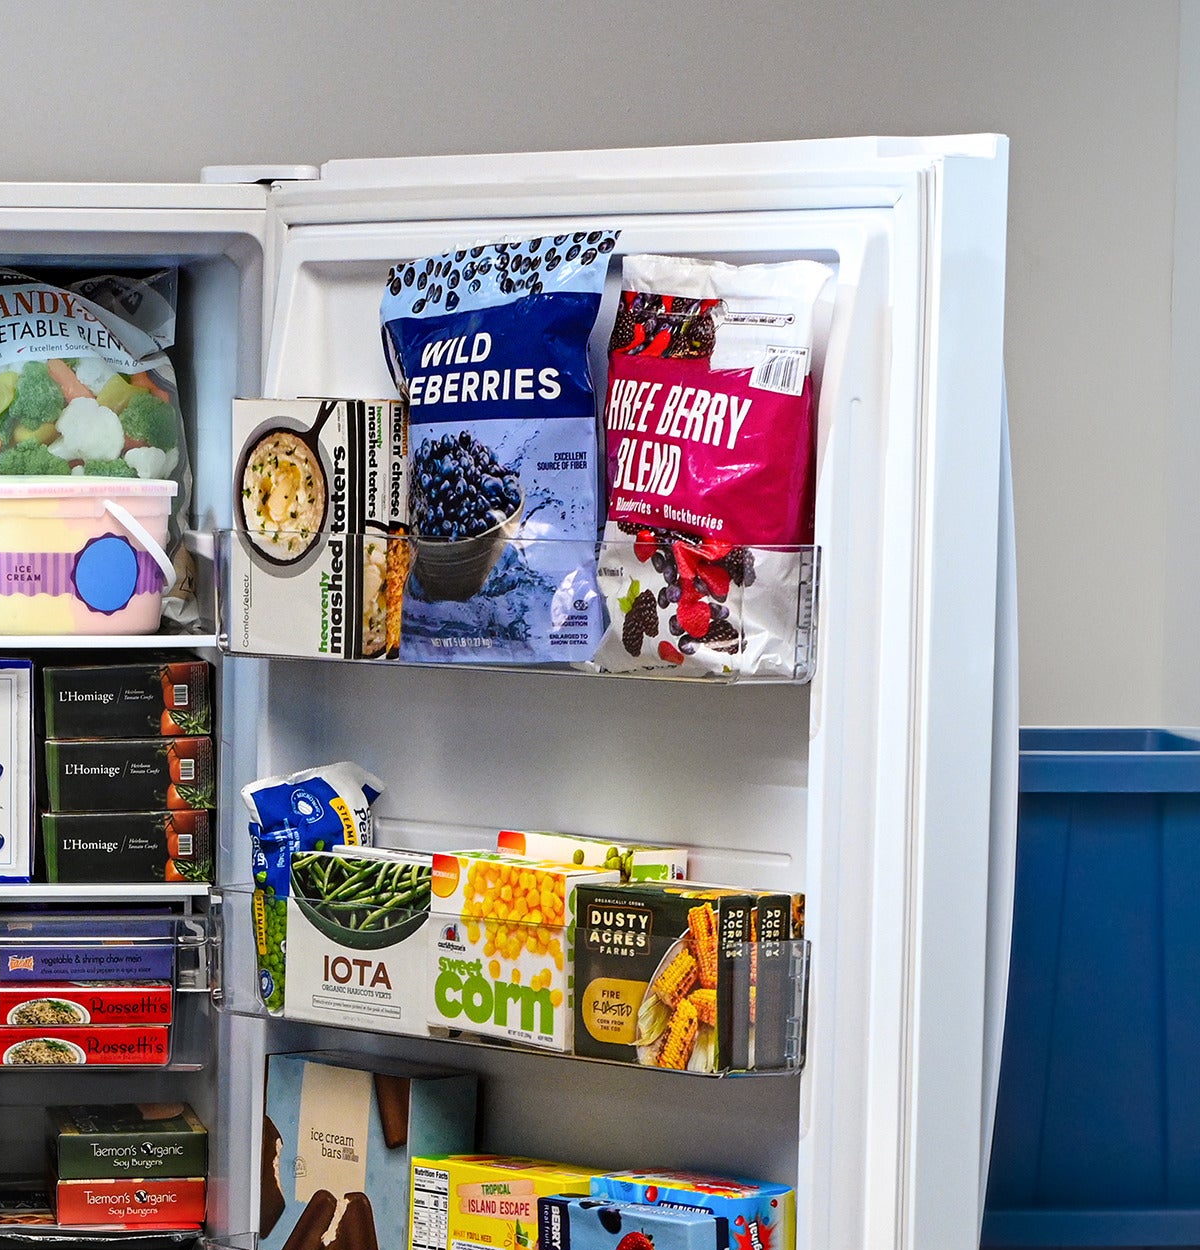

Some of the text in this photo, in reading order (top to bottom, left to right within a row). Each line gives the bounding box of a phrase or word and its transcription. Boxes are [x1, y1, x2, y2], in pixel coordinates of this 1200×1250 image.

[29, 344, 89, 353] Excellent Source
[420, 332, 492, 368] WILD
[407, 367, 563, 406] EBERRIES
[606, 378, 753, 450] HREE BERRY
[393, 406, 402, 442] mac
[368, 406, 378, 519] mashed taters
[537, 460, 587, 471] SOURCE OF FIBER
[554, 451, 587, 461] EXCELLENT
[613, 437, 682, 498] BLEND
[390, 461, 403, 517] cheese
[663, 504, 724, 531] Blackberries
[6, 573, 42, 581] CREAM
[14, 565, 32, 573] ICE
[328, 539, 344, 654] mashed
[317, 570, 330, 653] heavenly
[59, 690, 114, 705] L'Homiage
[65, 764, 121, 778] L'Homiage
[63, 839, 119, 853] L'Homiage
[591, 910, 649, 930] DUSTY
[589, 928, 647, 948] ACRES
[735, 909, 744, 957] DUSTY
[772, 909, 781, 957] DUSTY
[40, 954, 73, 967] vegetable
[599, 945, 636, 957] FARMS
[323, 954, 392, 990] IOTA
[438, 955, 483, 977] sweet
[321, 983, 346, 994] ORGANIC
[374, 990, 392, 1000] VERTS
[601, 989, 621, 1000] FIRE
[434, 971, 554, 1036] corn
[592, 1000, 633, 1017] ROASTED
[310, 1127, 354, 1147] ice cream
[321, 1142, 342, 1160] bars
[113, 1158, 163, 1169] Soy Burgers
[414, 1167, 448, 1180] Nutrition Facts
[481, 1183, 511, 1195] TROPICAL
[108, 1206, 159, 1218] Soy Burgers
[468, 1199, 530, 1216] ISLAND ESCAPE
[551, 1205, 561, 1250] BERRY
